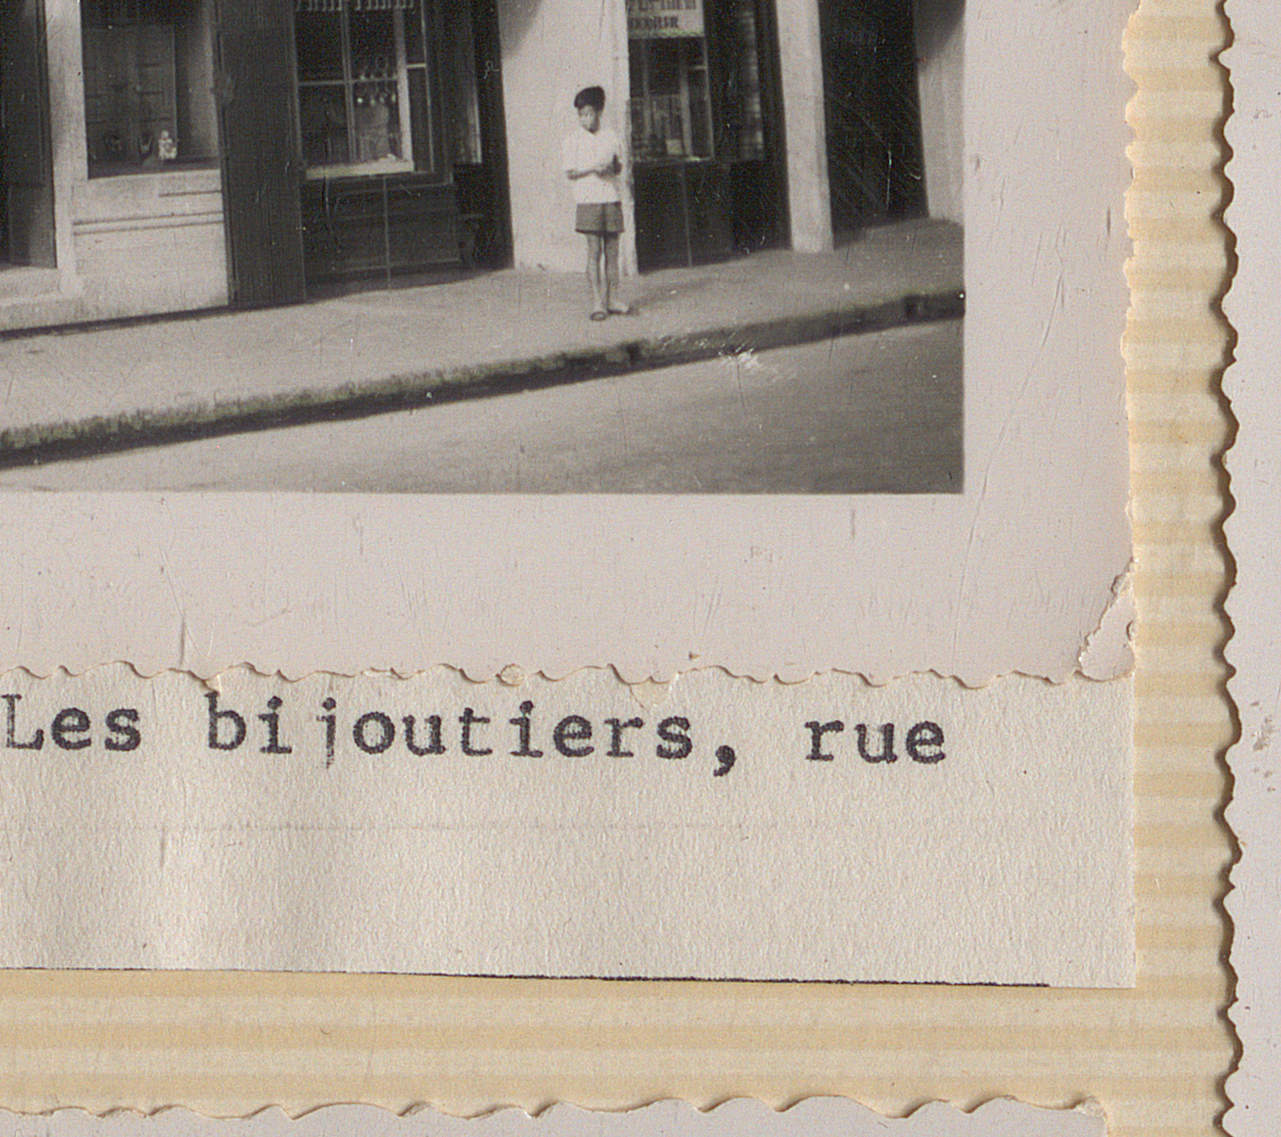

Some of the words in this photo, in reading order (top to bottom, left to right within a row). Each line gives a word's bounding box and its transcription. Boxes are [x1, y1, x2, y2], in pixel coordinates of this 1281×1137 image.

[0, 693, 143, 752] Les
[204, 690, 738, 777] bijoutiers,
[803, 719, 947, 764] rue
